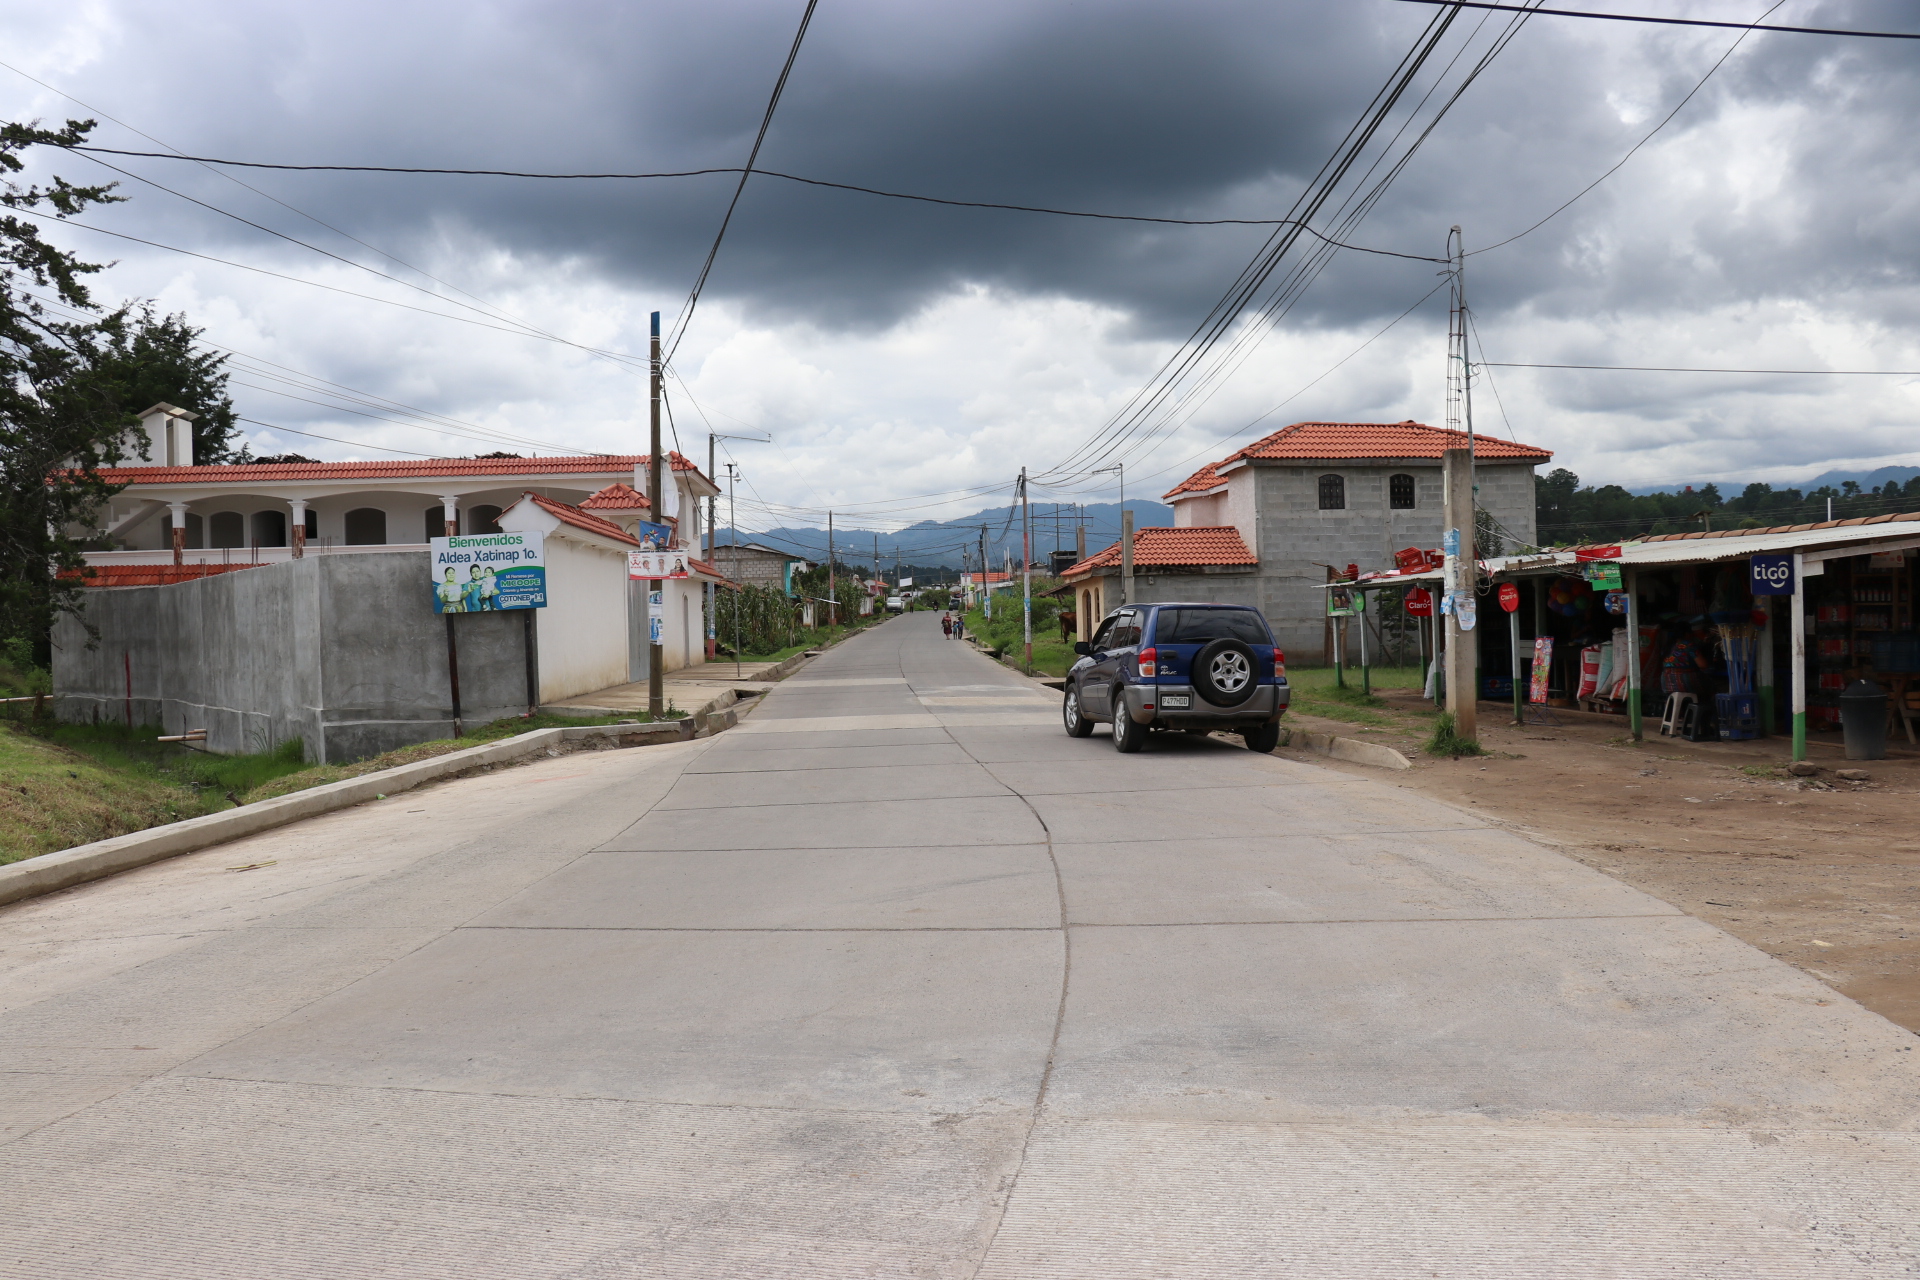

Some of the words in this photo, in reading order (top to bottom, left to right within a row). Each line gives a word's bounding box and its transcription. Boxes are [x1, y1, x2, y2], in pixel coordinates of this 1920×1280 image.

[448, 534, 523, 548] Bienvenidos
[438, 552, 471, 564] Aldea
[474, 549, 520, 563] Xatinap
[522, 547, 537, 559] 1o.
[501, 578, 541, 587] MICOOPE
[499, 594, 531, 603] COTONEB
[1408, 601, 1429, 609] Claro
